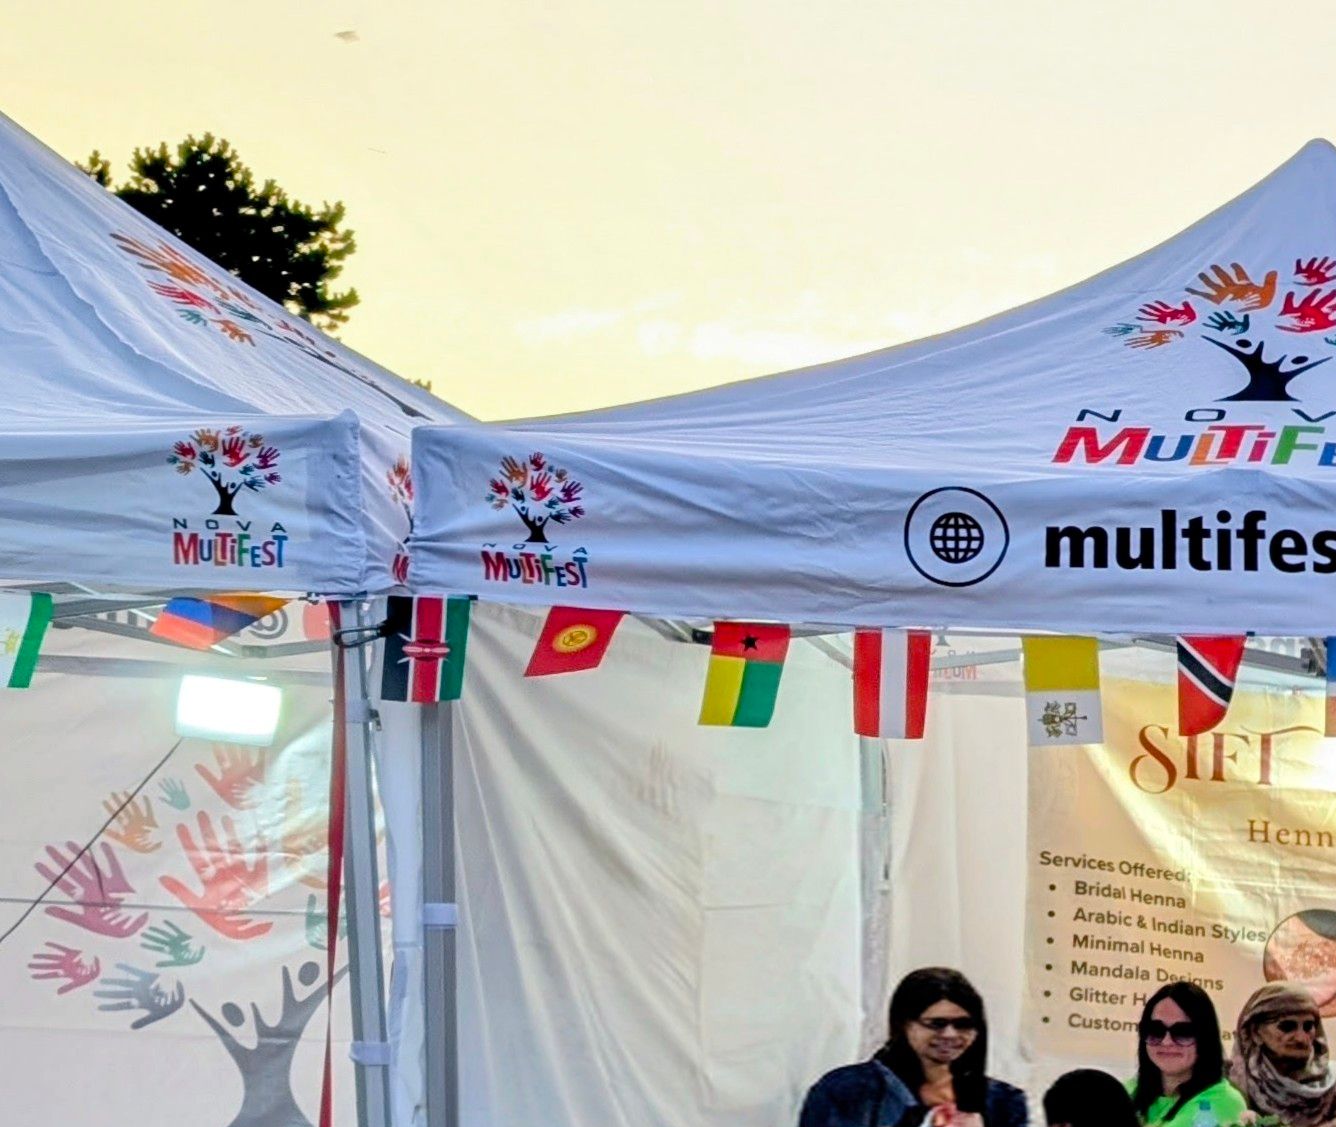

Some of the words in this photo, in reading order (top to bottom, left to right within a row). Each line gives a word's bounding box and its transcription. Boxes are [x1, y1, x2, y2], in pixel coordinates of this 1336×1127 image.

[173, 518, 287, 533] NOVA
[1039, 850, 1116, 873] Services
[1118, 860, 1192, 882] Offered:
[1074, 880, 1127, 900] Bridal
[1130, 888, 1187, 909] Henna
[1072, 907, 1133, 927] Arabic
[1136, 914, 1148, 930] &
[1151, 917, 1206, 937] Indian
[1210, 923, 1268, 944] Styles
[1071, 933, 1146, 954] Minimal
[1149, 942, 1206, 964] Henna
[1070, 960, 1151, 981] Mandala
[1069, 987, 1128, 1006] Glitter
